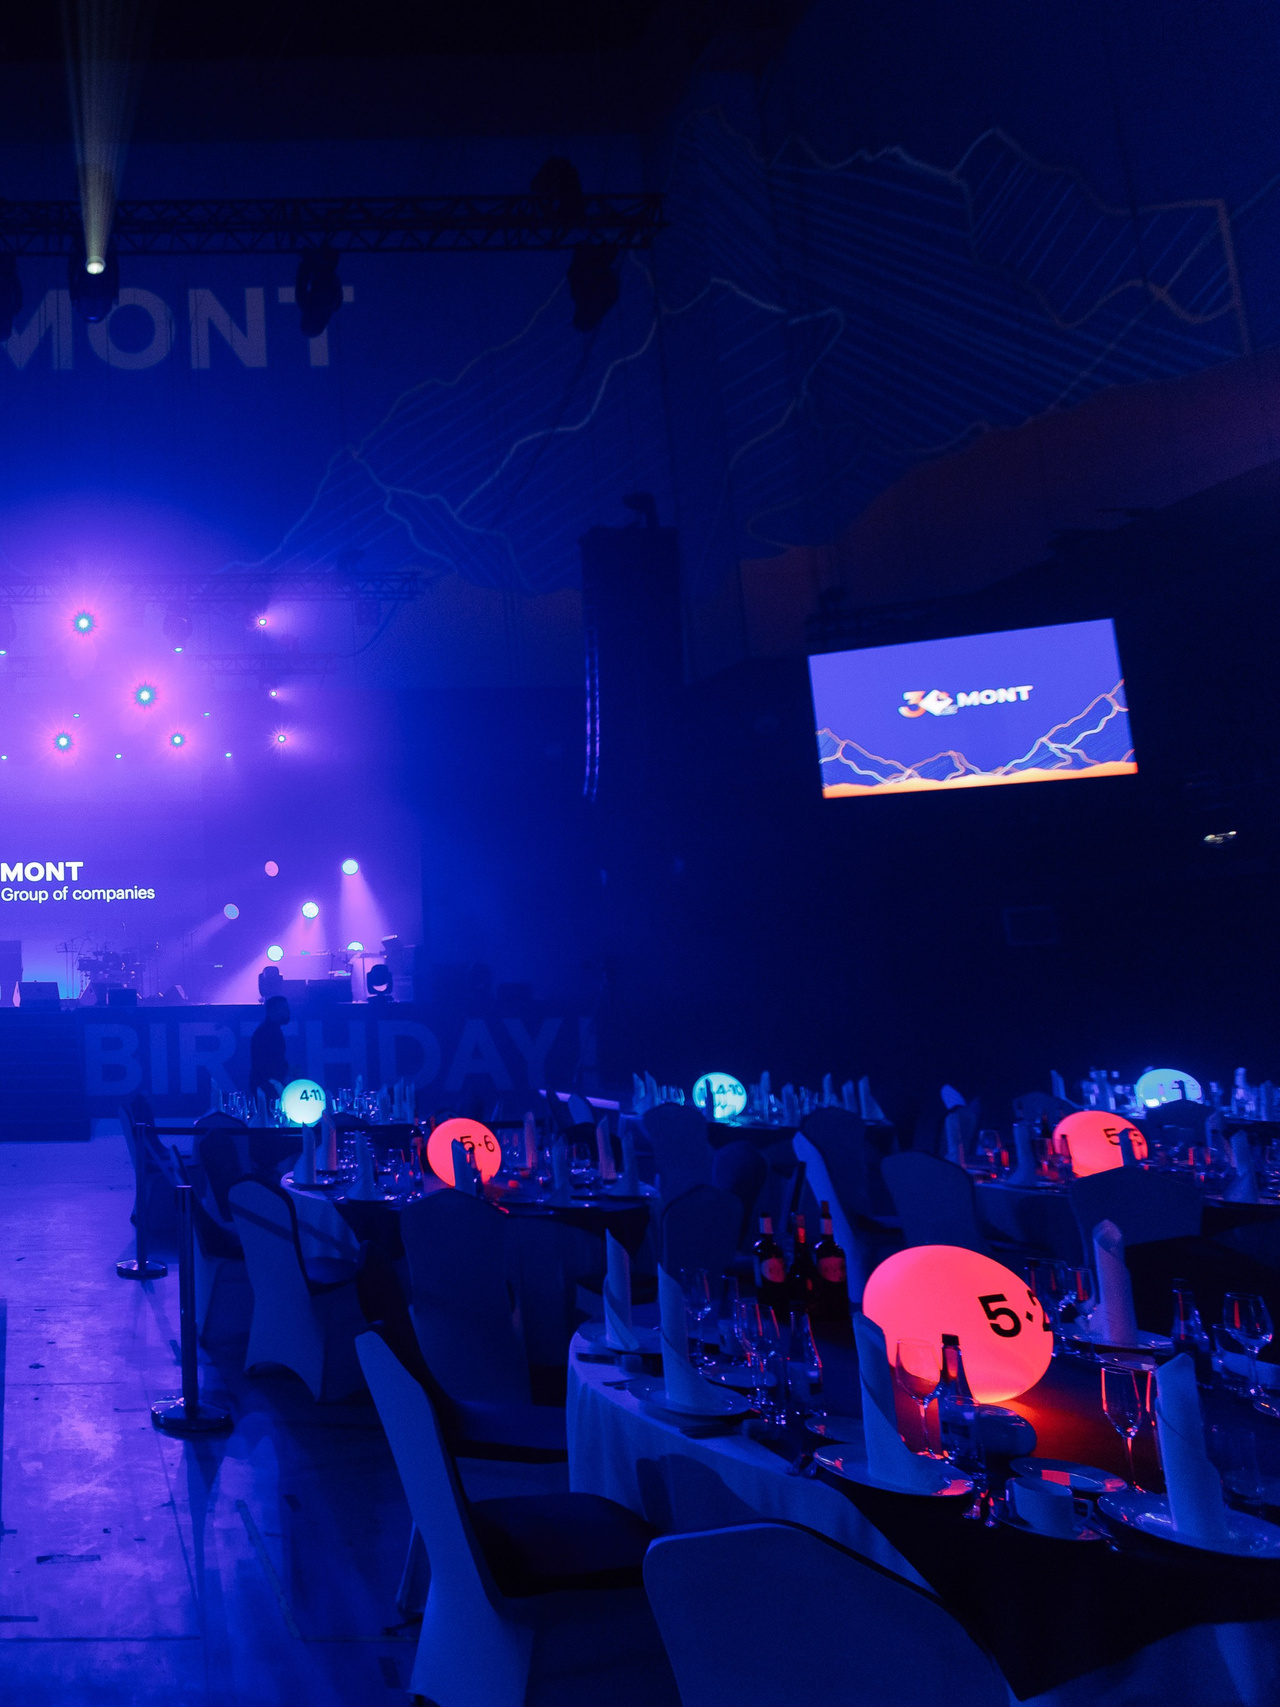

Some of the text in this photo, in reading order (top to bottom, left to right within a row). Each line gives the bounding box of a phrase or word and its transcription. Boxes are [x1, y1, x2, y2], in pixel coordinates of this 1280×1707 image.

[956, 685, 1034, 708] MONT
[0, 861, 84, 882] MONT
[1, 885, 156, 904] Group of companies
